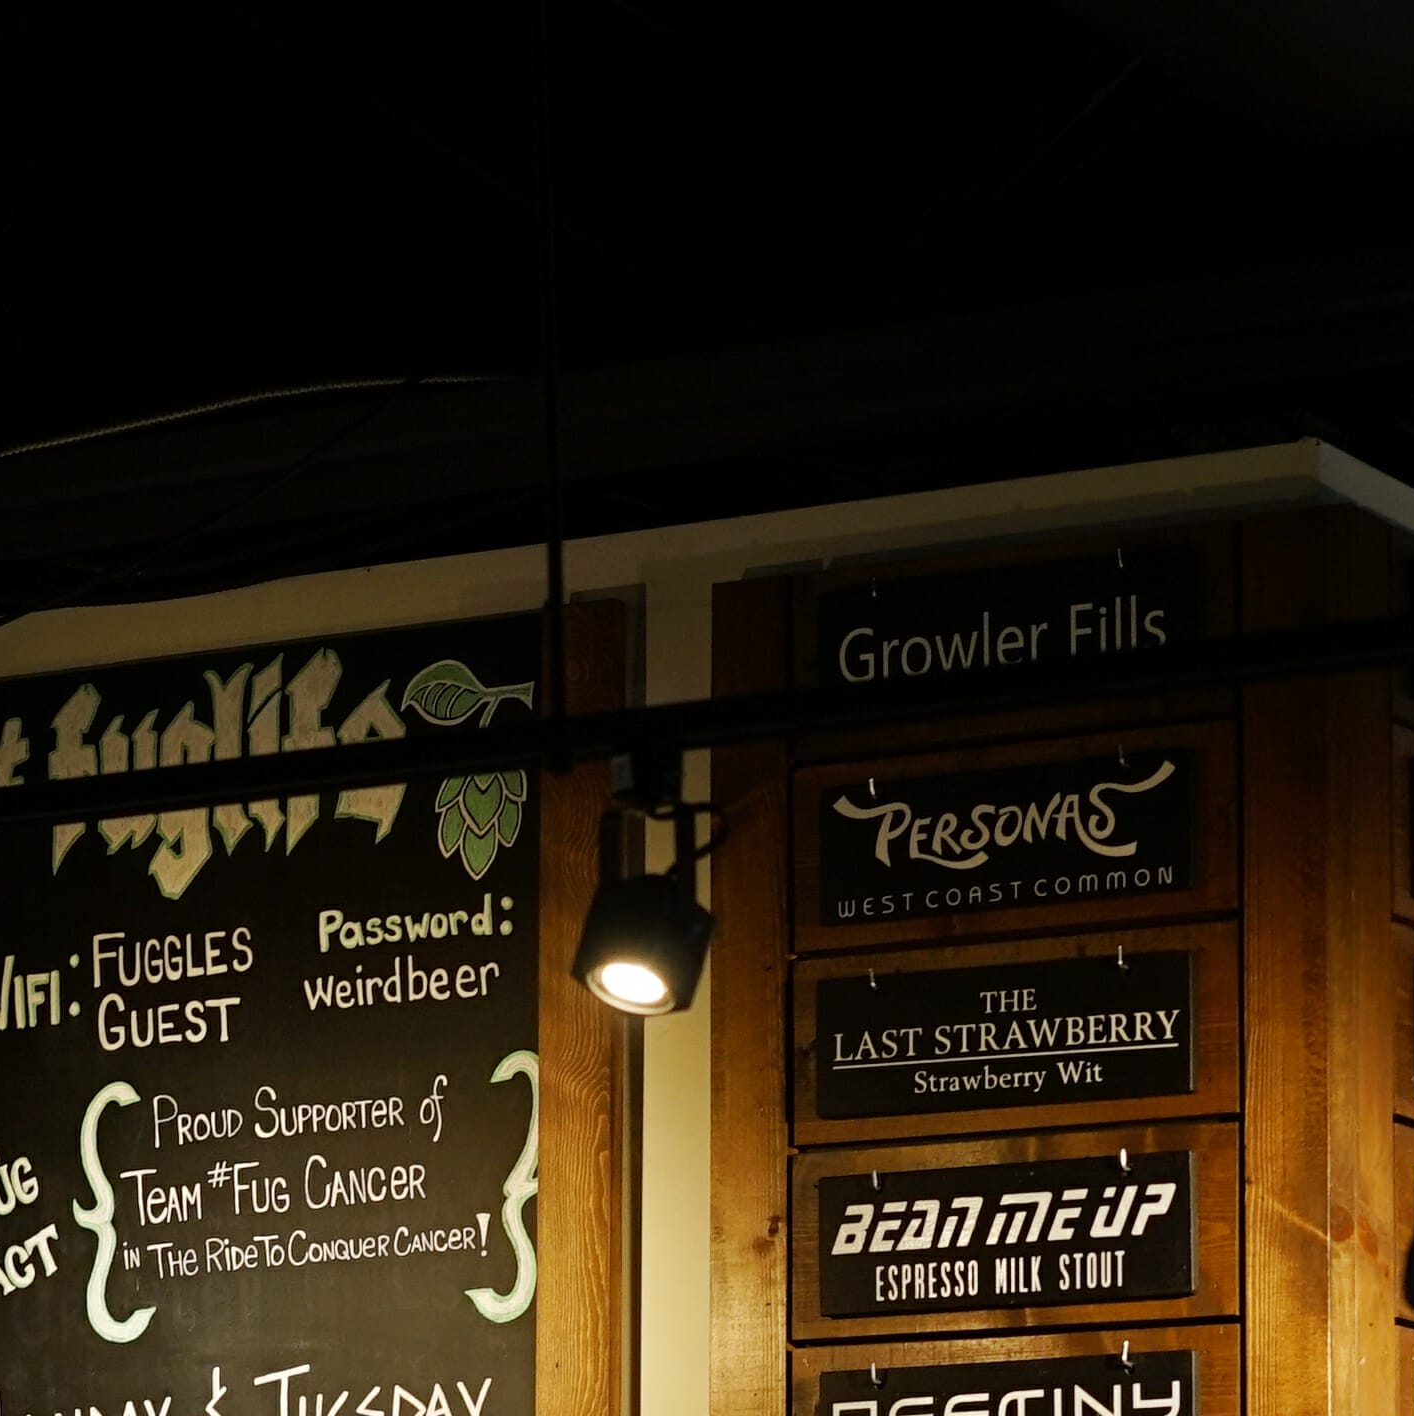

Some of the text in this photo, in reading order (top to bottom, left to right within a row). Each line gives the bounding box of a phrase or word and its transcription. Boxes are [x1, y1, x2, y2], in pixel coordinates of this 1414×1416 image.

[839, 594, 1167, 682] Growler Fills
[833, 759, 1176, 868] PERSONAS
[838, 865, 1174, 919] WEST COAST COMMON
[318, 894, 515, 953] Password:
[92, 927, 254, 989] FUGGLES
[96, 998, 241, 1051] GUEST
[980, 989, 1036, 1014] THE
[833, 1009, 1180, 1062] LAST STRAWBERRY
[914, 1060, 1103, 1094] Strawberry Wit
[153, 1094, 245, 1149] PROUD
[419, 1074, 448, 1141] of
[831, 1182, 1176, 1256] BEAN ME UP
[875, 1250, 1125, 1302] ESPRESSO MILK STOUT
